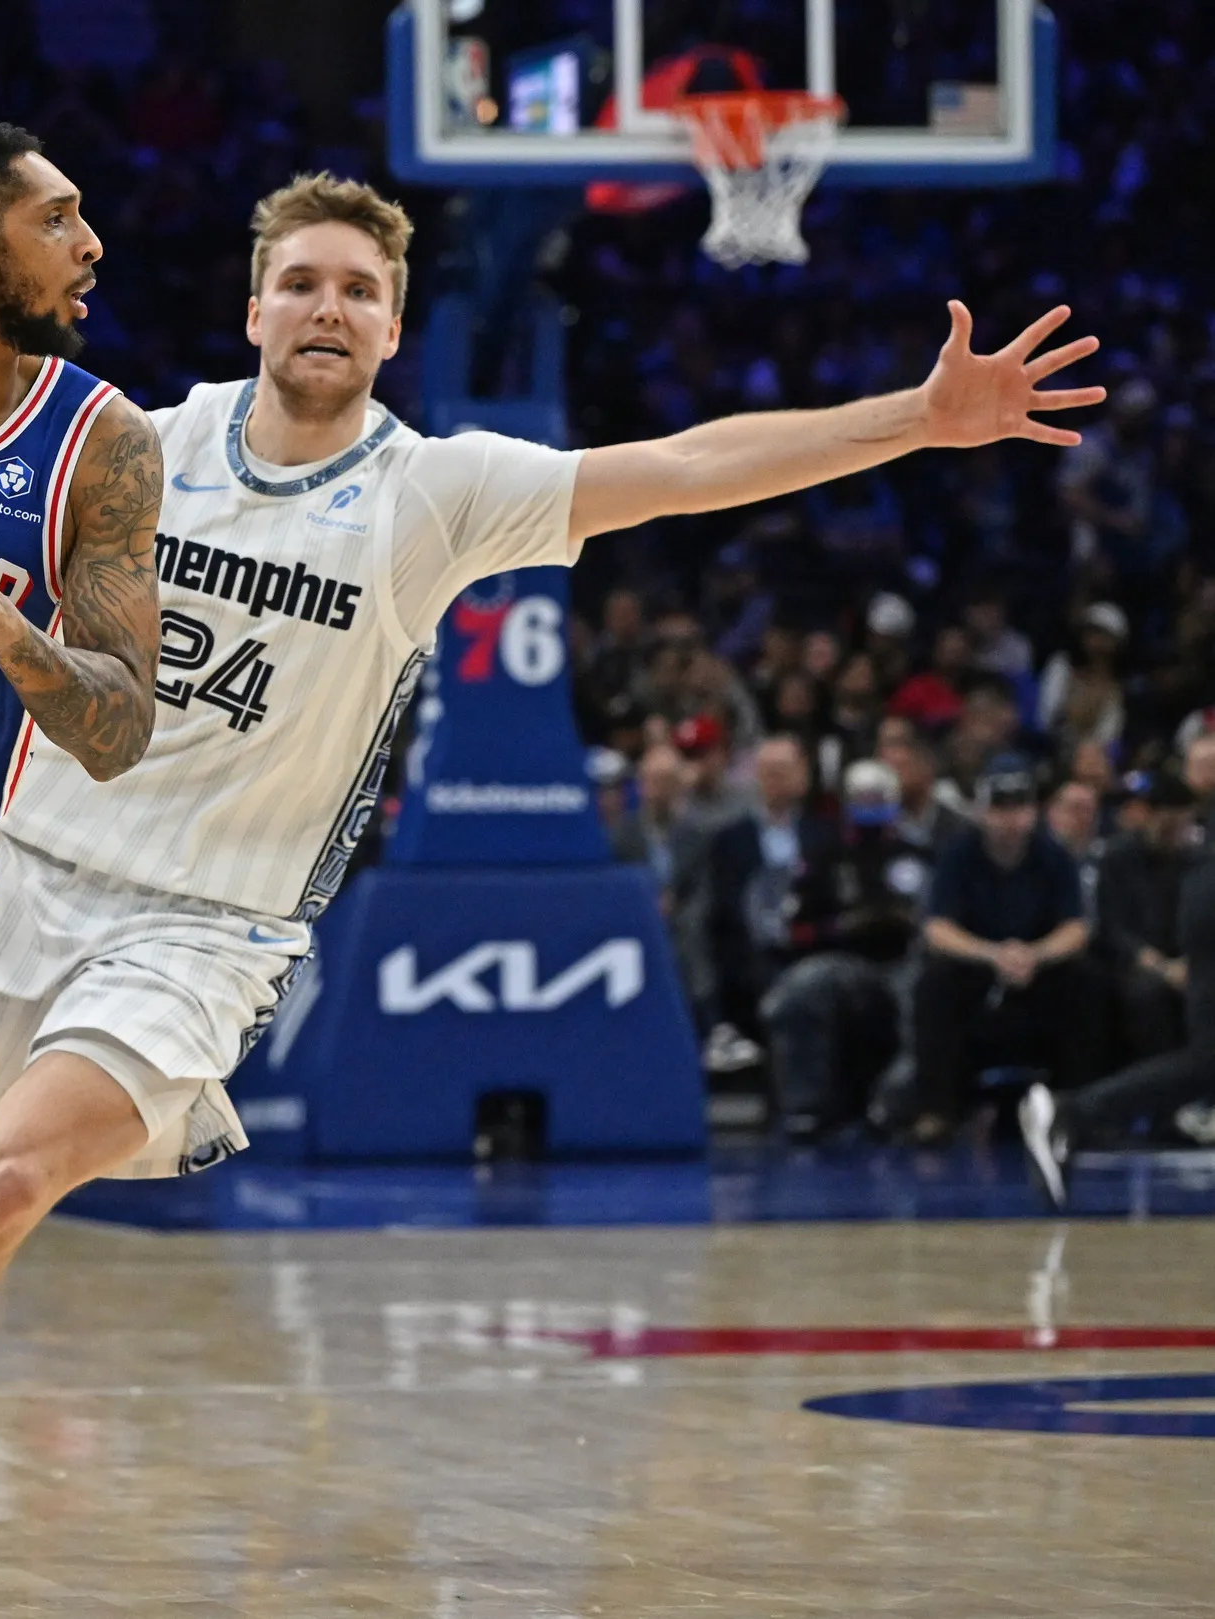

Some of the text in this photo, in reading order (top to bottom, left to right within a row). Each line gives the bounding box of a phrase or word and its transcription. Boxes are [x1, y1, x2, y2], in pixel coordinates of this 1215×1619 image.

[155, 609, 275, 733] 24
[453, 594, 567, 687] 76
[378, 938, 645, 1014] KIA
